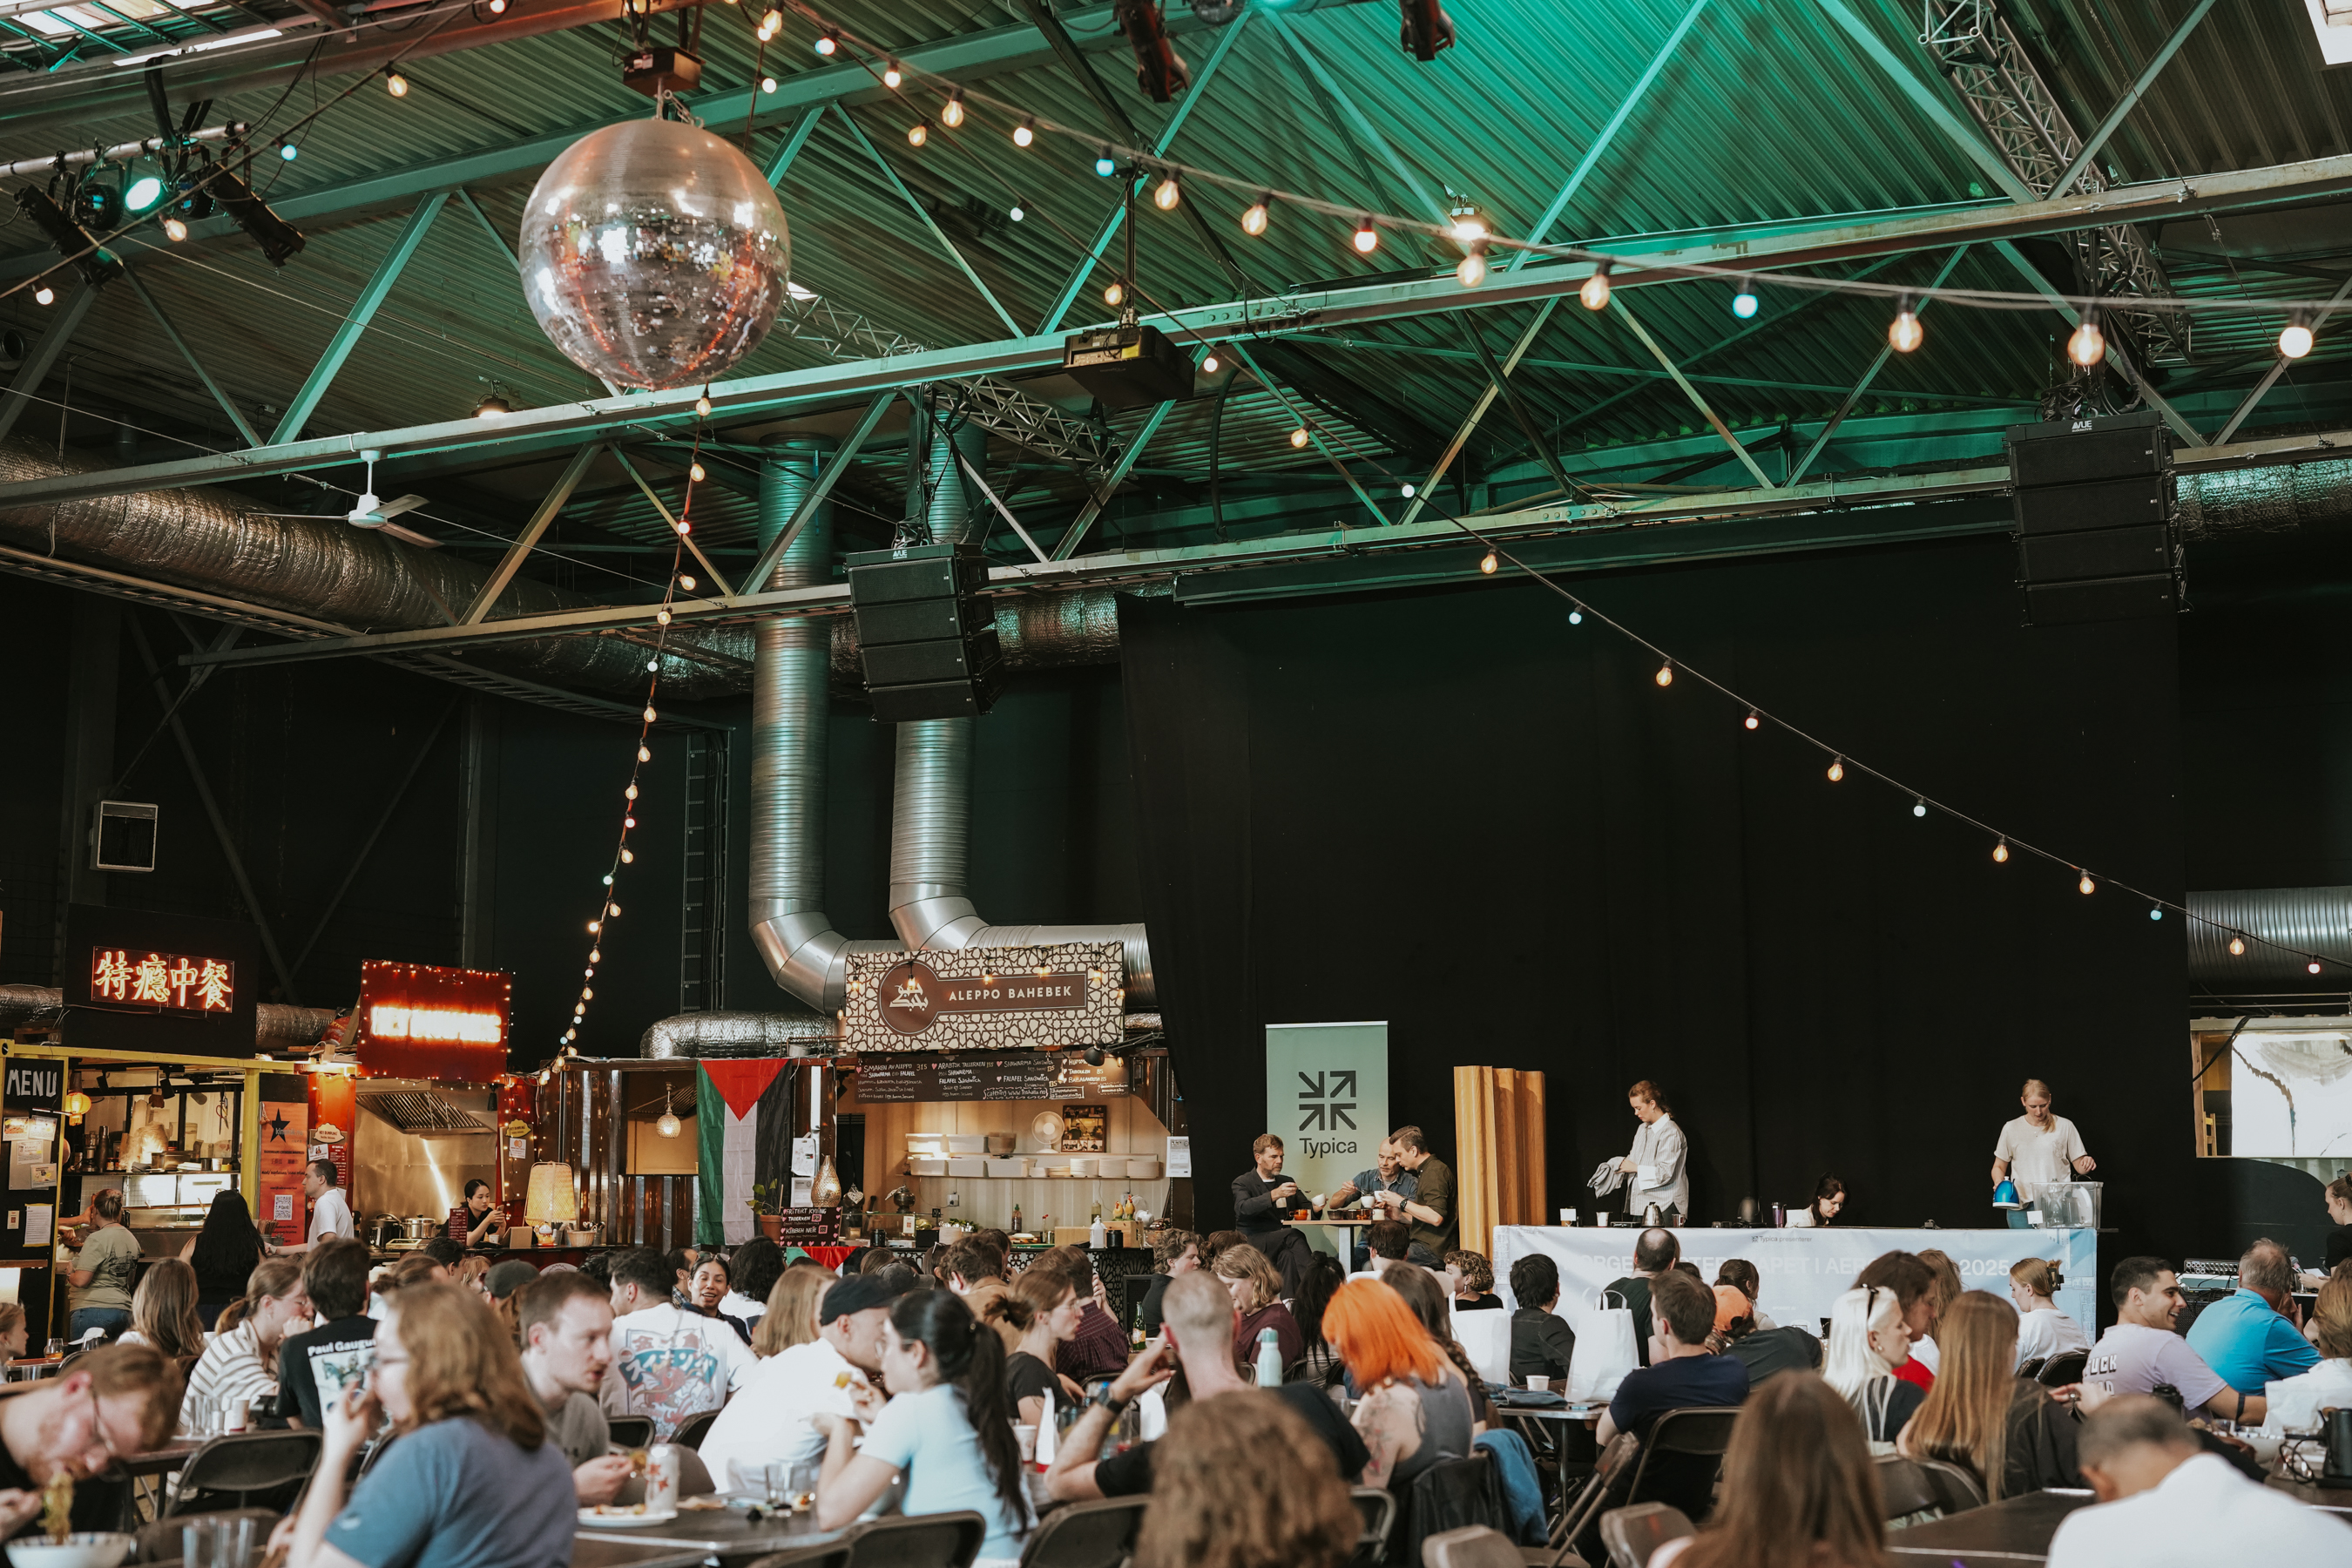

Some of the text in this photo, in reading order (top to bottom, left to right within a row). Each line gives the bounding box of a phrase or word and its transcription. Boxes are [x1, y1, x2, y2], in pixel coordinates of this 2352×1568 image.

[949, 985, 1072, 1001] ALEPPO BAHEBEK
[6, 1069, 57, 1098] MENU
[1299, 1138, 1357, 1159] Typica
[1959, 1259, 2011, 1276] 2025
[308, 1342, 335, 1357] Paul
